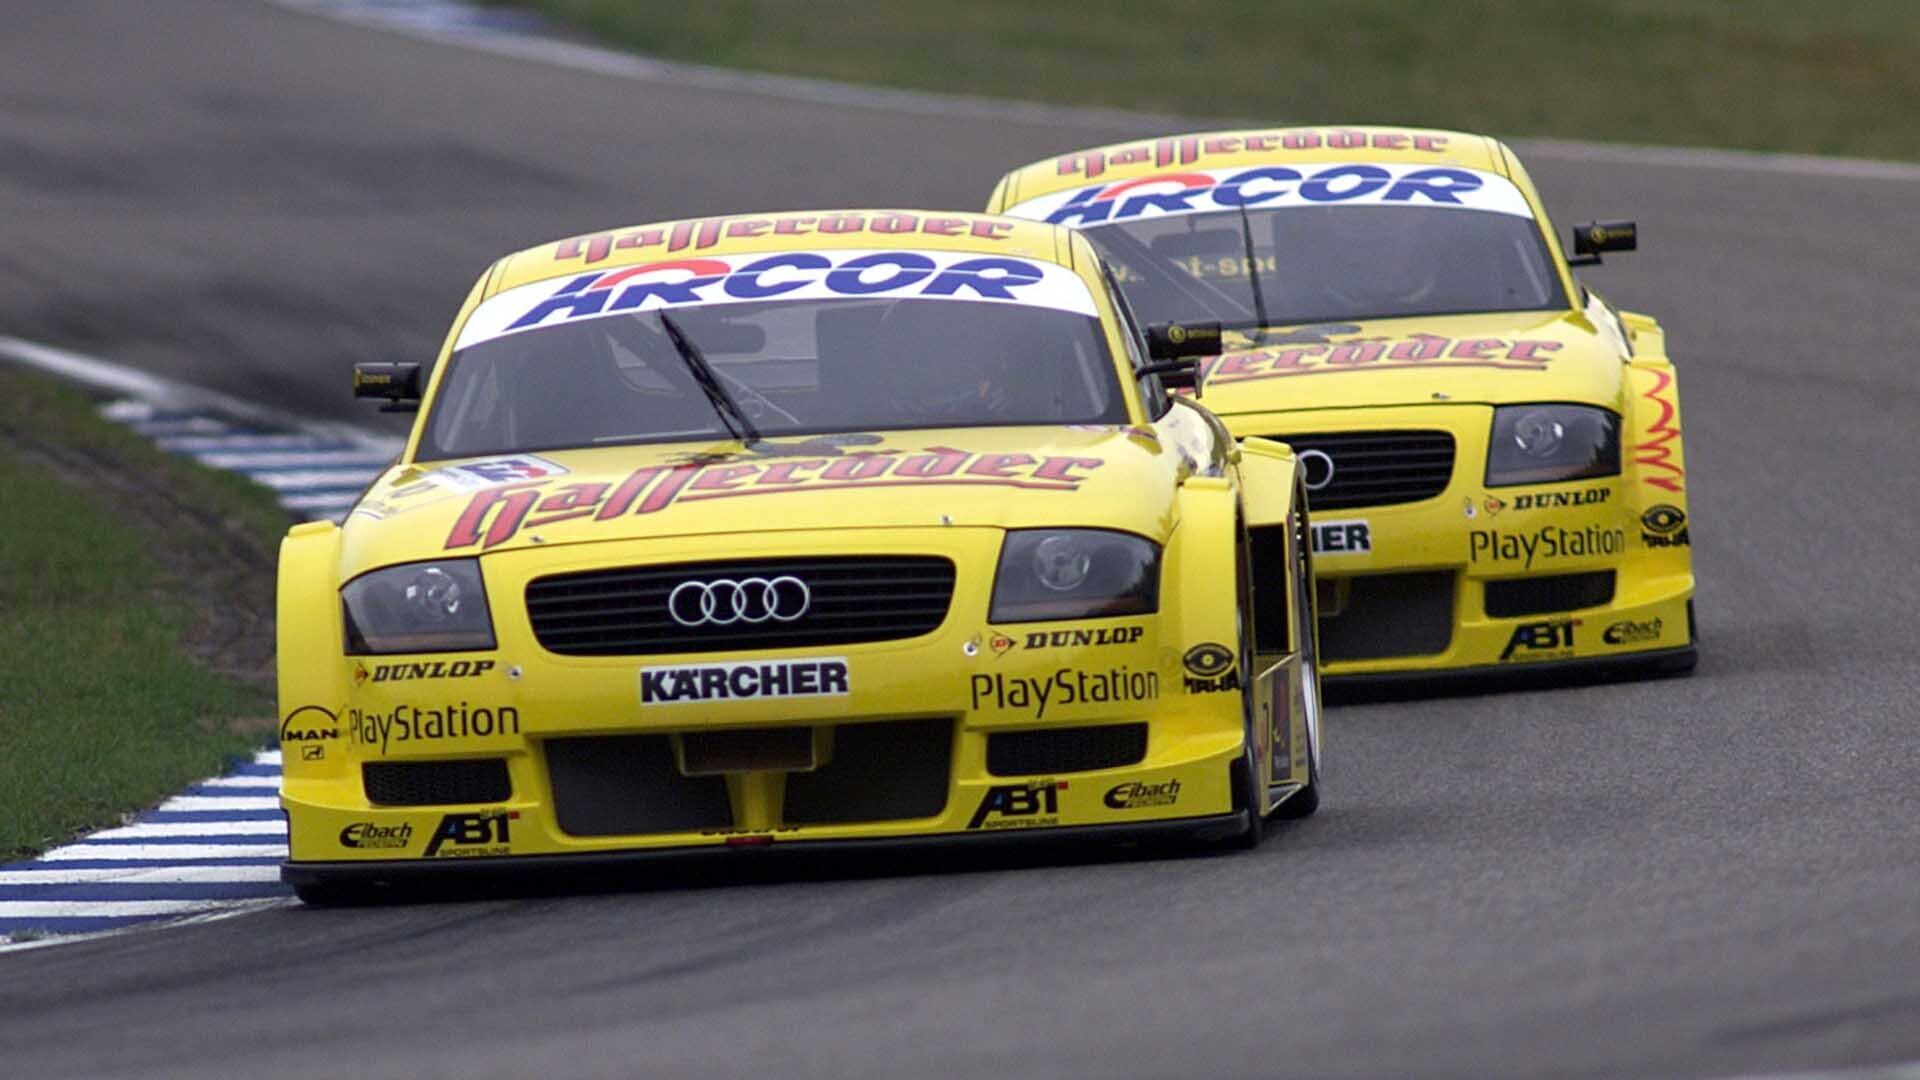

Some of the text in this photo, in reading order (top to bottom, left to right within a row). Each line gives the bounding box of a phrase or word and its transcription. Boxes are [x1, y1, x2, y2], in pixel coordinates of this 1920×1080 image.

[1046, 166, 1483, 224] ARCOR
[504, 251, 1043, 331] ARCOR
[1513, 489, 1611, 511] DUNLOP
[1469, 525, 1625, 568] PlayStation
[1024, 627, 1143, 649] DUNLOP
[1500, 621, 1573, 660] ABT
[372, 660, 495, 682] DUNLOP
[641, 662, 848, 703] KÄRCHER
[972, 666, 1158, 719] PlayStation
[286, 729, 338, 741] MAN
[350, 702, 519, 755] PlayStation
[966, 782, 1058, 829] ABT
[1103, 779, 1181, 809] Eibach
[340, 822, 413, 848] Eibach
[423, 813, 510, 857] ABT
